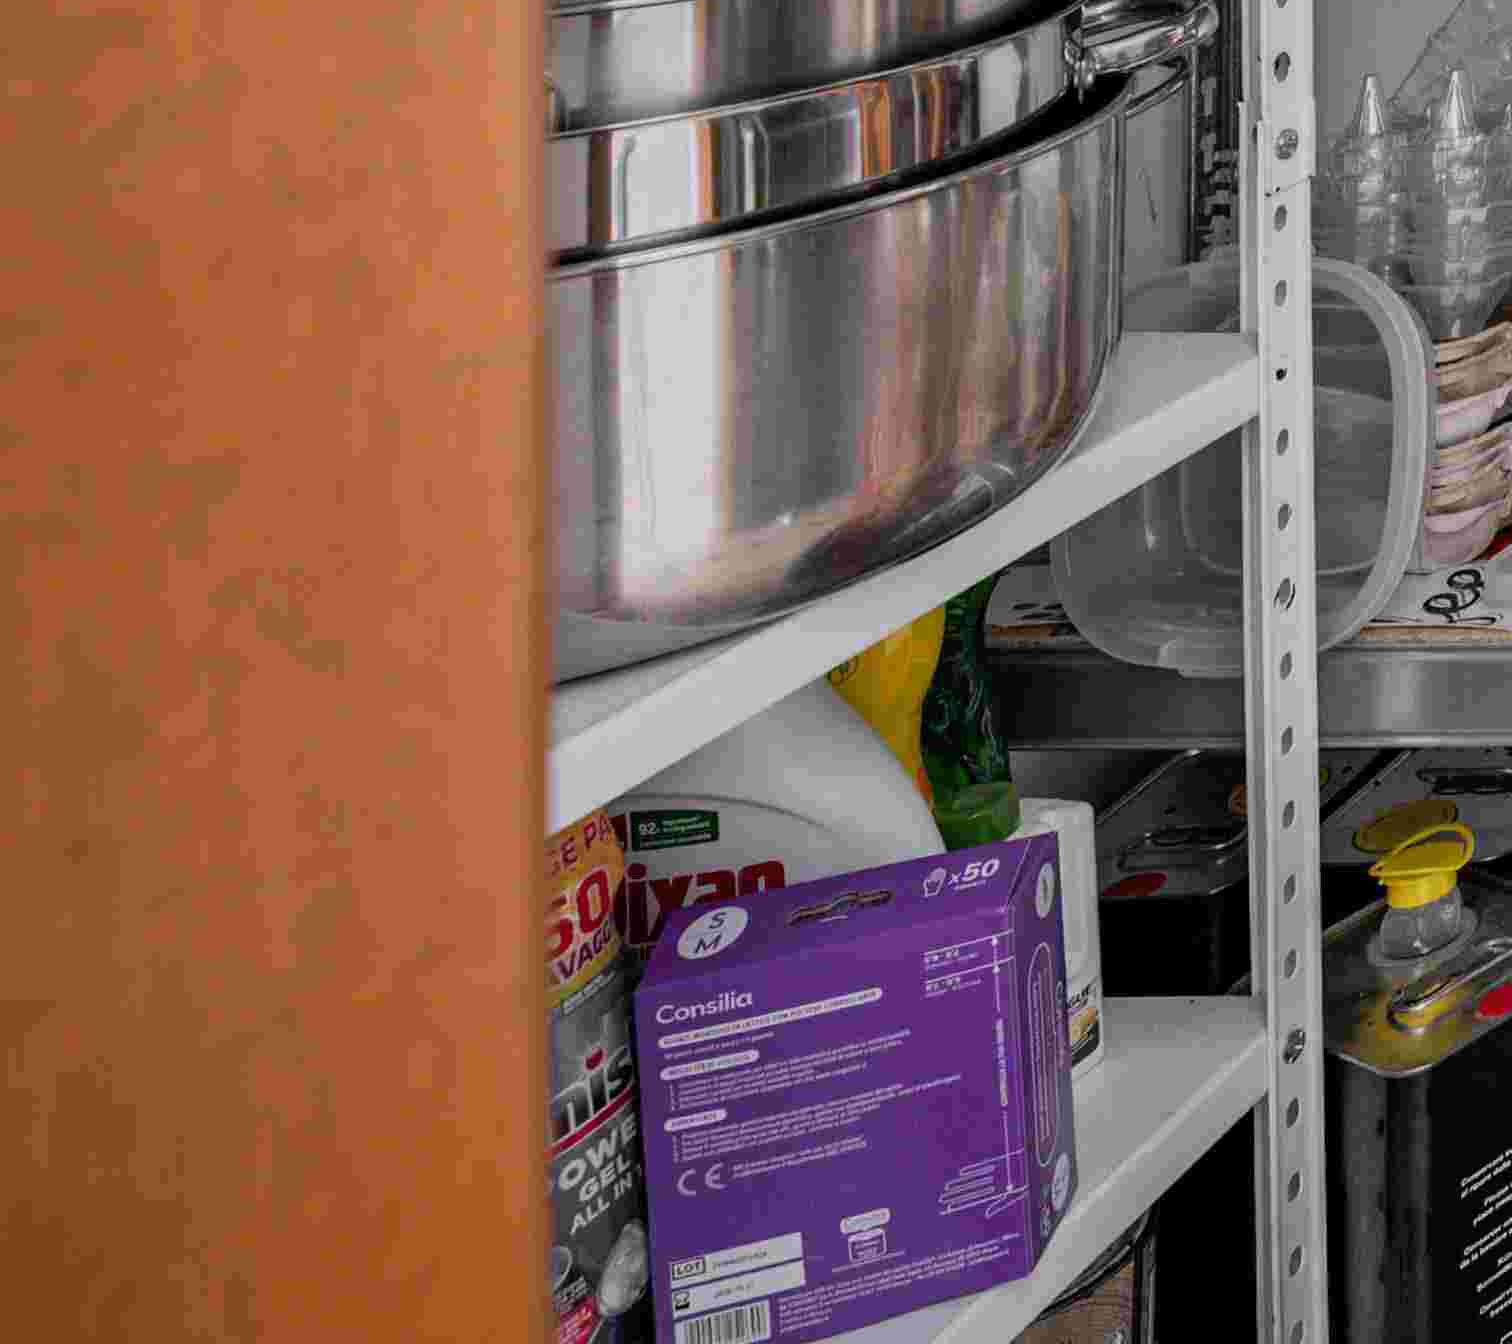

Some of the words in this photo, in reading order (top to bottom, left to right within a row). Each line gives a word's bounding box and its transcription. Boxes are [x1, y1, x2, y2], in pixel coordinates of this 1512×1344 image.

[708, 911, 728, 929] S
[694, 935, 722, 955] M
[655, 990, 754, 1025] Consilia
[674, 1262, 703, 1277] LOT
